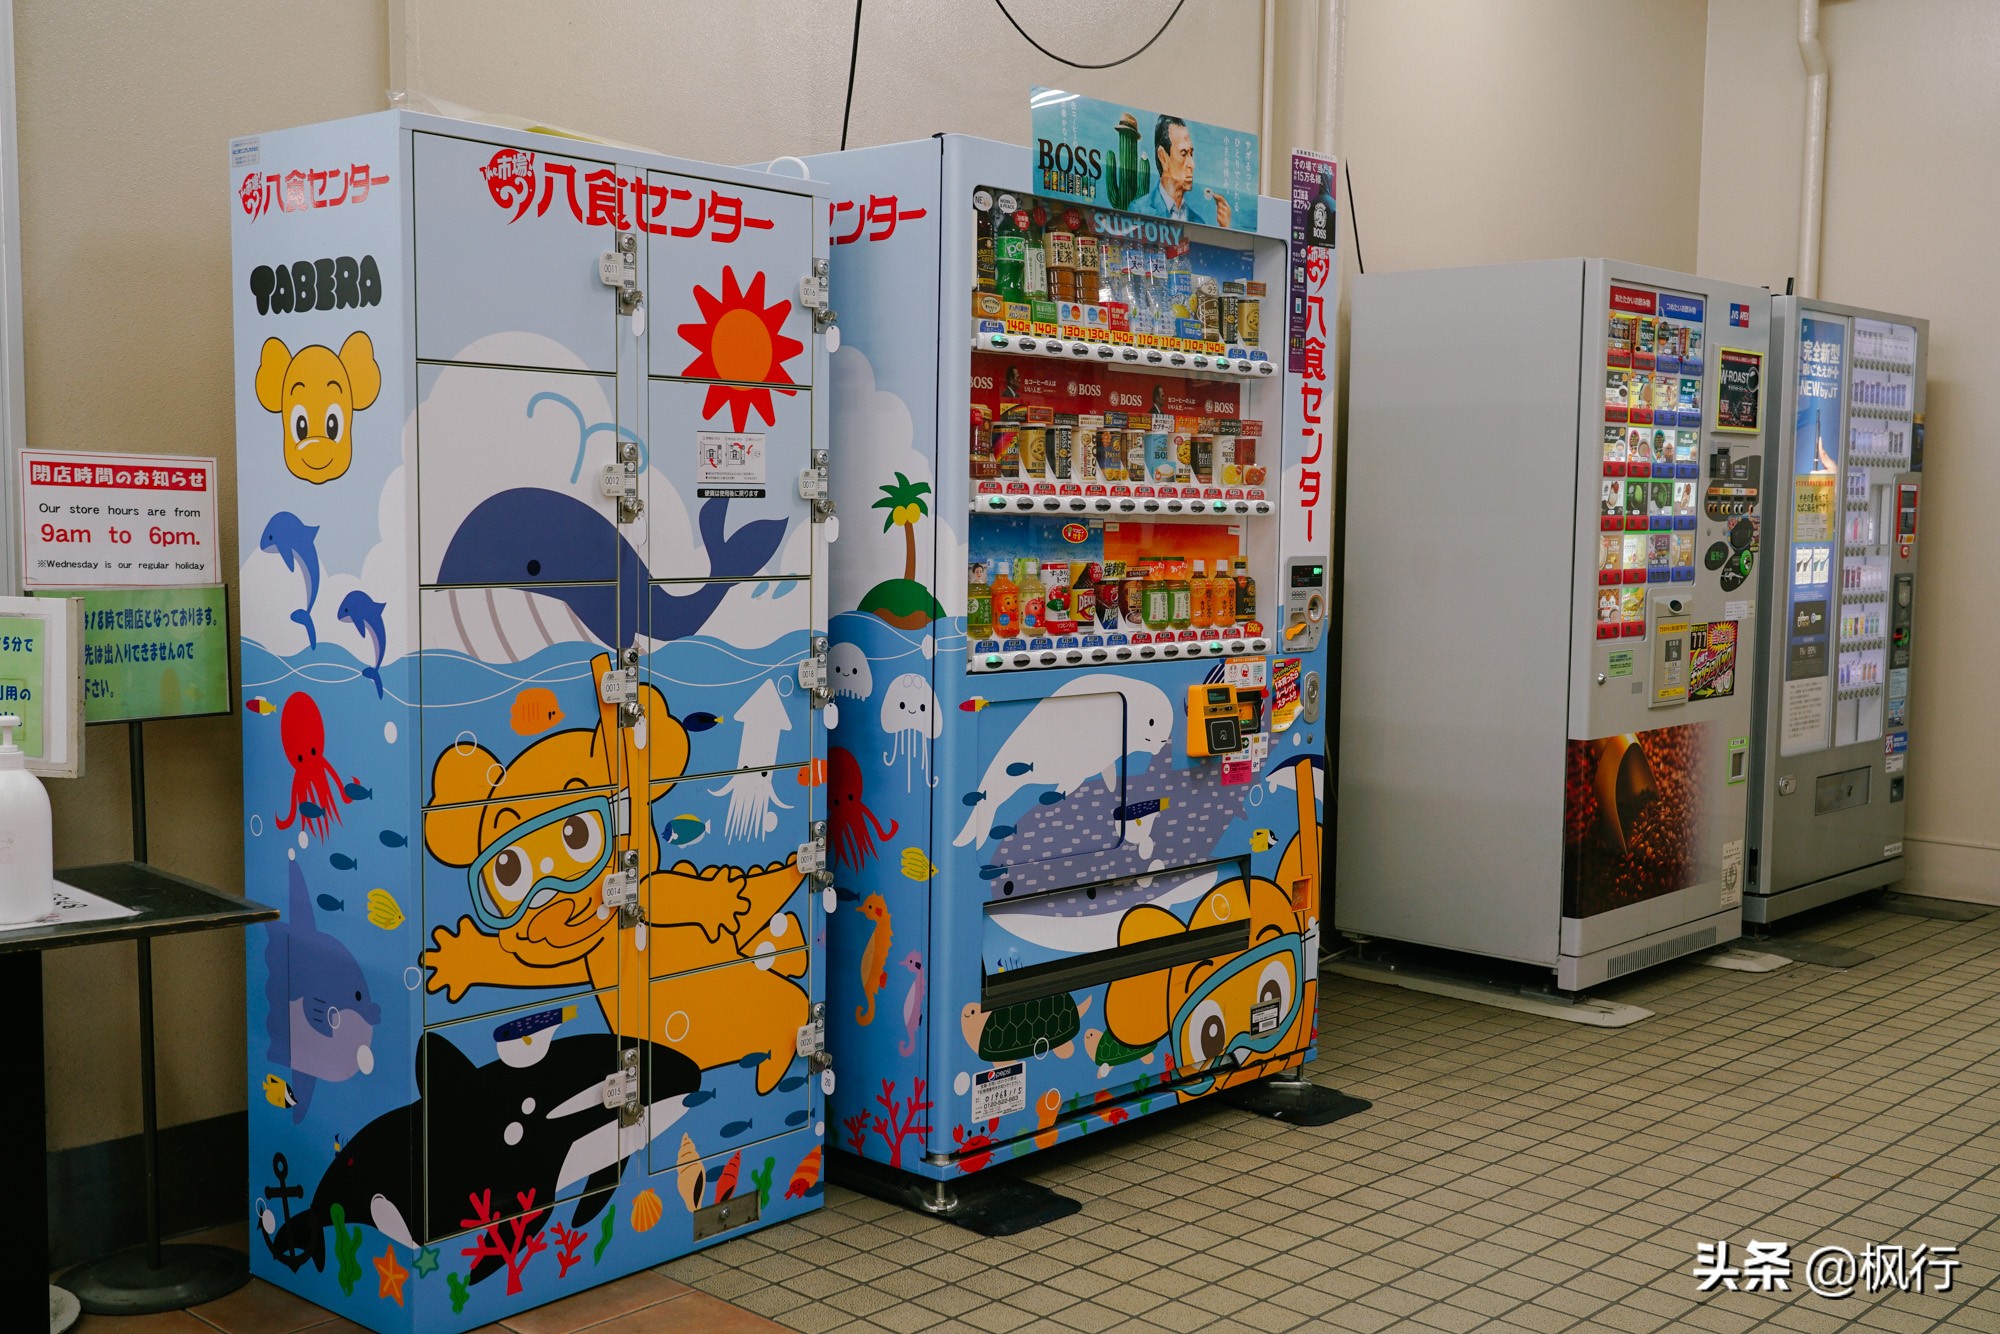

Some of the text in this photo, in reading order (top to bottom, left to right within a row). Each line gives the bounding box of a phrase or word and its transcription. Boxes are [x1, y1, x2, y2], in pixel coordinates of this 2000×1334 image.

[1037, 138, 1102, 180] BOSS
[263, 163, 390, 215] 八食センター
[537, 161, 775, 243] 八食センター
[1094, 213, 1183, 246] SUNTORY
[1313, 228, 1327, 239] BOSS
[1052, 242, 1073, 250] やさしい
[1054, 250, 1074, 264] 麦茶
[1080, 254, 1098, 268] 麦茶
[604, 264, 618, 273] 0011
[250, 254, 382, 316] TABERA
[803, 287, 816, 297] 0016
[1007, 320, 1030, 332] 140円
[1034, 322, 1057, 334] 140円
[1063, 325, 1085, 337] 130円
[1088, 327, 1110, 340] 130円
[1112, 331, 1134, 343] 140円
[1138, 334, 1158, 346] 110円
[1160, 337, 1181, 348] 110円
[1183, 339, 1203, 350] 110円
[1206, 341, 1225, 352] 140円
[1803, 340, 1840, 364] 完全新型
[1078, 383, 1101, 396] BOSS
[1800, 379, 1839, 399] NEW by JT
[1120, 394, 1142, 406] BOSS
[1214, 401, 1234, 414] BOSS
[32, 464, 205, 488] 閉店時間のお知らせ
[605, 476, 620, 486] 0012
[802, 480, 815, 489] 0017
[704, 489, 759, 497] 硬貨は使用後に戻ります
[39, 502, 201, 518] Our store hours are from
[41, 524, 201, 547] 9am to 6pm.
[105, 560, 112, 569] is
[118, 562, 132, 570] our
[138, 560, 169, 573] regular
[175, 560, 205, 571] holiday
[84, 641, 194, 666] 先は出入りできませんので
[802, 669, 815, 679] 0018
[1275, 669, 1299, 690] 1本買ったら
[605, 683, 621, 693] 0013
[1276, 682, 1297, 699] ルーレット
[800, 855, 813, 863] 0019
[606, 887, 621, 896] 0014
[801, 1036, 813, 1047] 0020
[995, 1068, 1012, 1078] pepsi
[824, 1078, 832, 1088] 20
[607, 1086, 622, 1097] 0015
